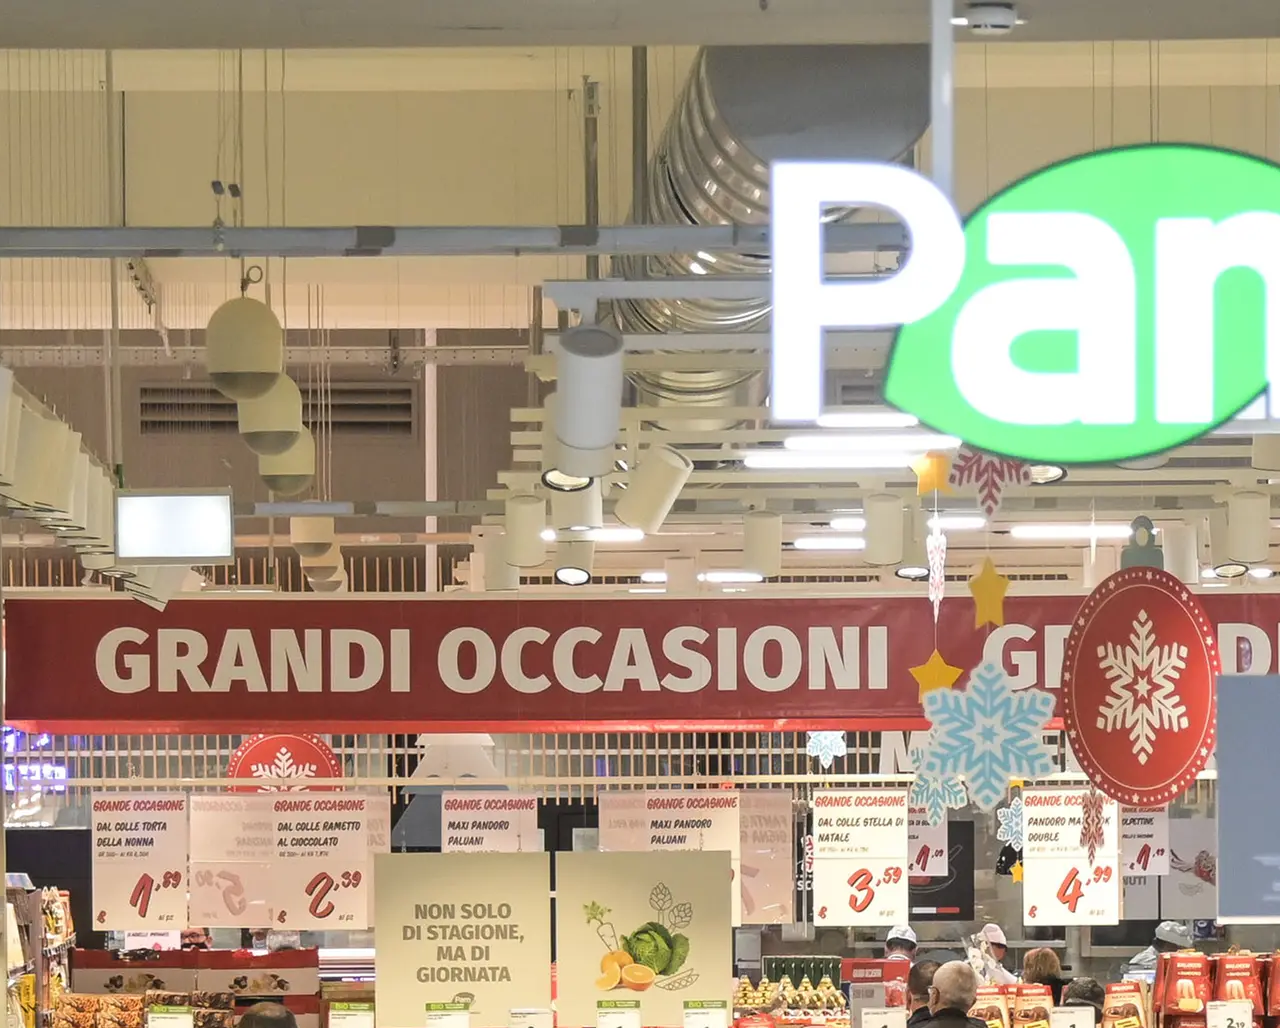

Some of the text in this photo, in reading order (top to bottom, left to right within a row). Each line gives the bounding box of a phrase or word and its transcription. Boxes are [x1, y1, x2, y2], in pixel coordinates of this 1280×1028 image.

[95, 624, 889, 695] GRANDI OCCASIONI
[93, 800, 184, 812] GRANDE OCCASIONE
[274, 800, 365, 812] GRANDE OCCASIONE
[445, 798, 535, 810] GRANDE OCCASIONE
[647, 797, 737, 810] GRANDE OCCASIONE
[815, 796, 905, 807] GRANDE OCCASIONE
[1024, 795, 1062, 807] GRANDE
[96, 821, 167, 832] DAL COLLE TORTA
[277, 821, 360, 832] DAL COLLE RAMETTO
[448, 820, 510, 831] MAXI PANDORO
[650, 820, 672, 829] MAXI
[675, 819, 712, 829] PANDORO
[817, 818, 833, 827] DAL
[836, 818, 860, 826] COLLE
[863, 817, 892, 826] STELLA
[895, 817, 903, 826] DI
[1028, 817, 1066, 826] PANDORO
[96, 837, 154, 847] DELLA NONNA
[277, 837, 338, 847] AL CIOCCOLATO
[448, 836, 483, 846] PALUANI
[651, 835, 686, 845] PALUANI
[818, 833, 850, 842] NATALE
[1028, 833, 1059, 841] DOUBLE
[129, 870, 182, 918] 1,89
[304, 870, 362, 918] 2,39
[847, 867, 902, 913] 3,59
[1056, 866, 1113, 913] 4,99
[414, 904, 512, 919] NON SOLO
[402, 924, 524, 942] DI STAGIONE,
[436, 946, 490, 961] MA DI
[416, 966, 511, 982] GIORNATA
[1226, 1018, 1245, 1028] 2,19
